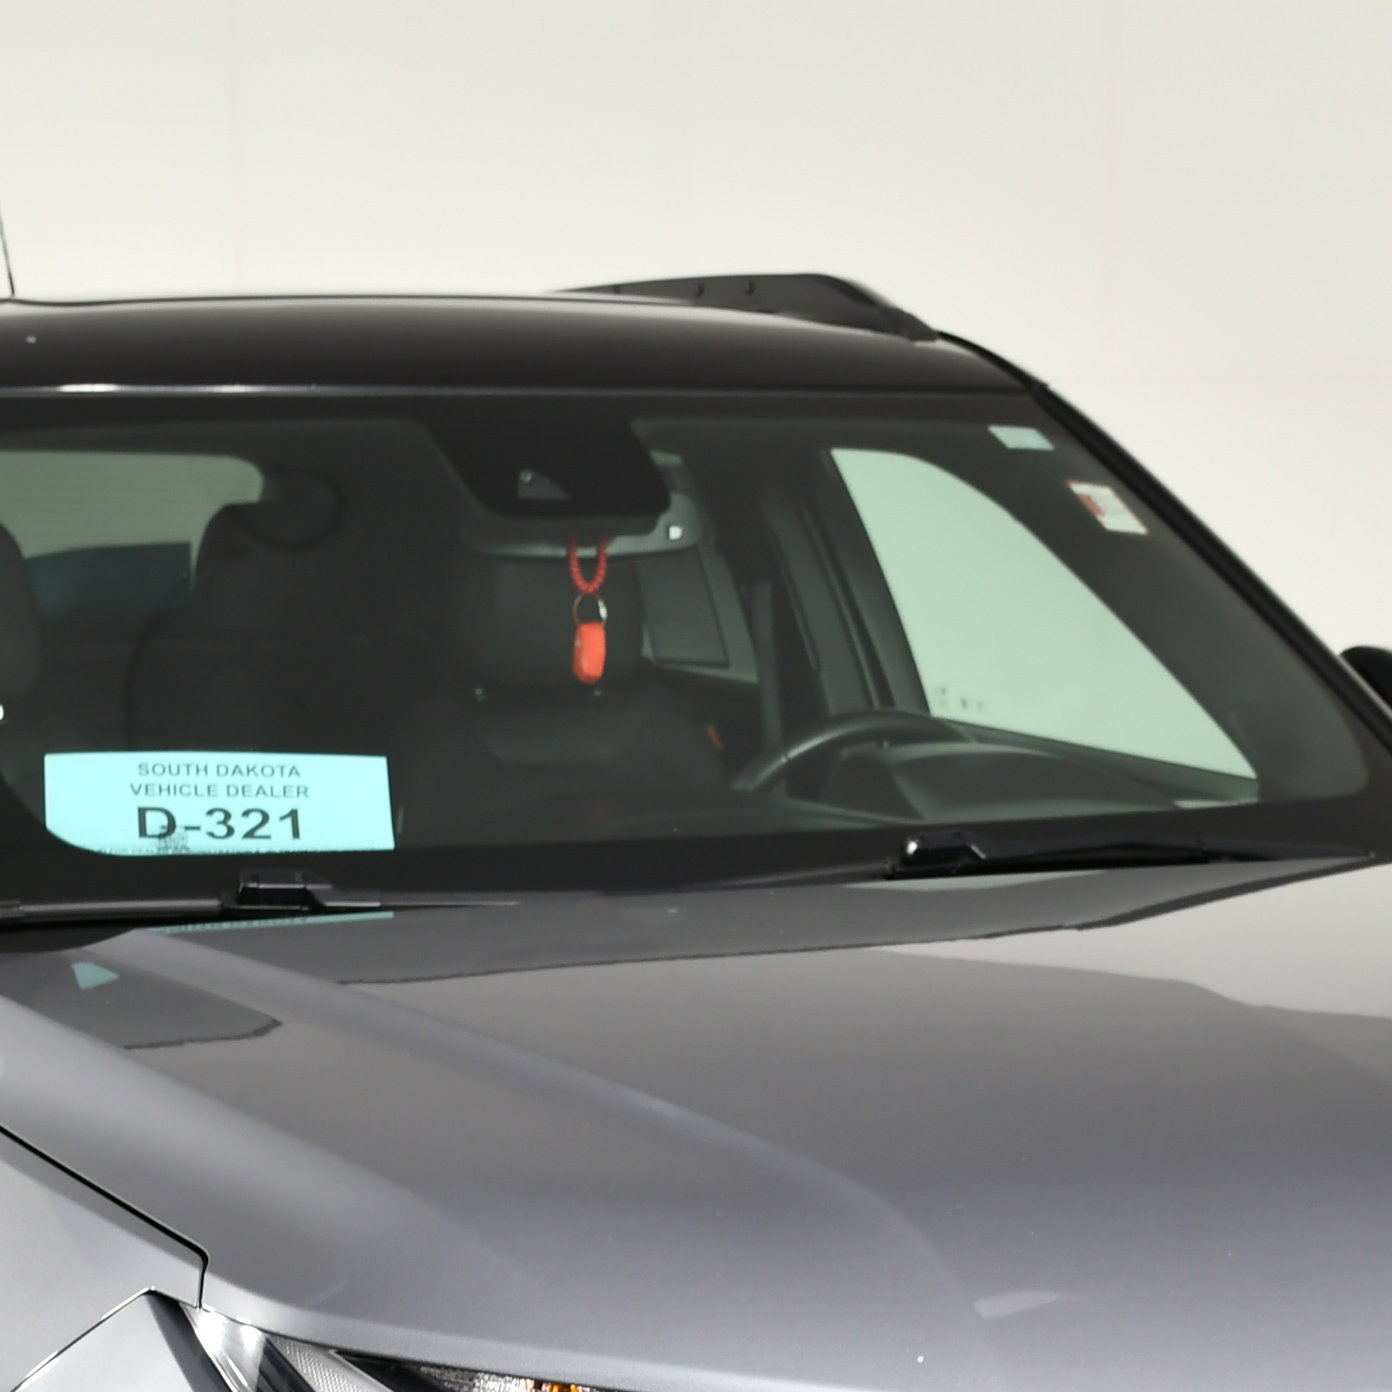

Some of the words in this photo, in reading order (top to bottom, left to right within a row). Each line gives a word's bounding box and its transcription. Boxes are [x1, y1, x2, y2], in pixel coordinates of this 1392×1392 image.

[138, 762, 209, 778] SOUTH
[216, 762, 302, 779] DAKOTA
[129, 783, 218, 798] VEHICLE
[226, 784, 310, 799] DEALER
[136, 806, 301, 840] D-321
